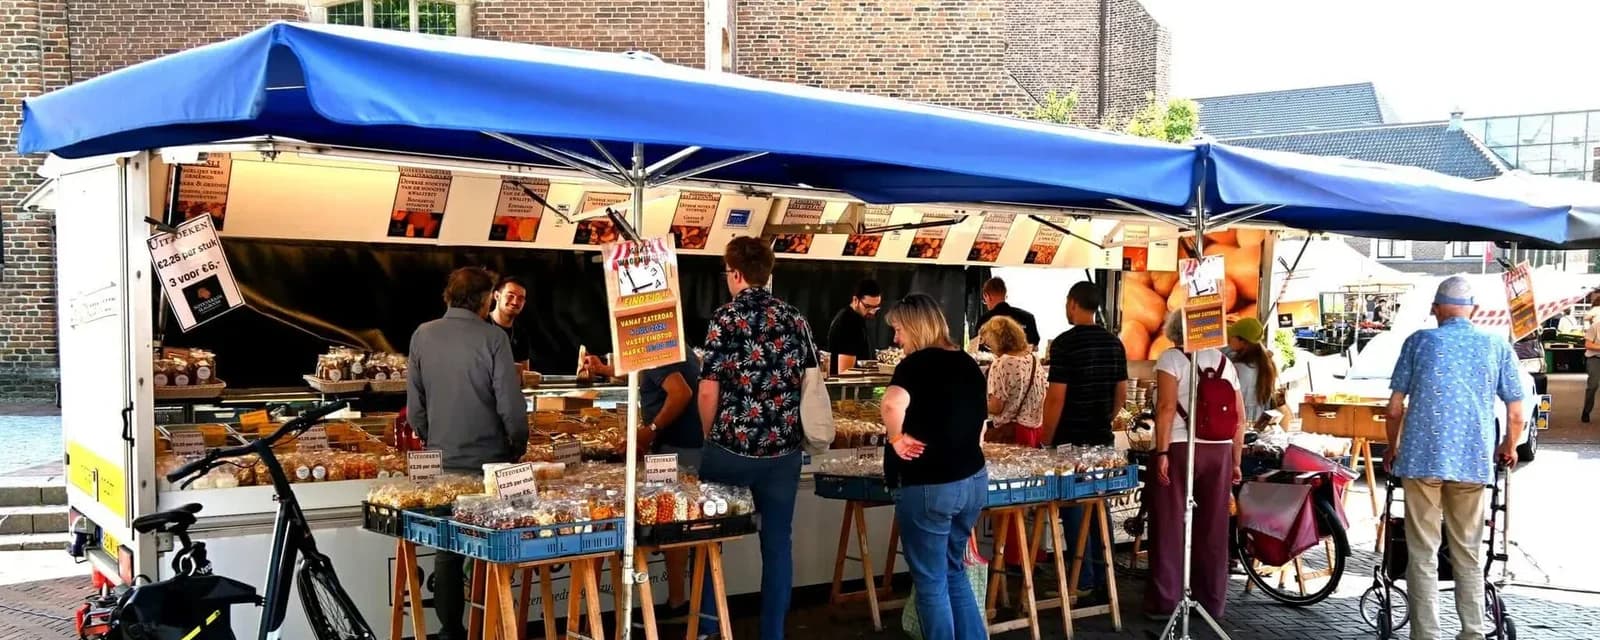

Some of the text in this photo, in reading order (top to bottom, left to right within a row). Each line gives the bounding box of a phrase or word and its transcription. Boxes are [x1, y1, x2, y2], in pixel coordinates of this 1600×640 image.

[157, 238, 218, 270] €2,25 per stuk
[169, 278, 177, 288] 3
[178, 269, 200, 284] voor
[620, 311, 674, 328] VANAF ZATERDAG
[626, 336, 645, 346] VASTE
[496, 466, 530, 478] UITZOEKEN
[500, 482, 513, 490] €2,25
